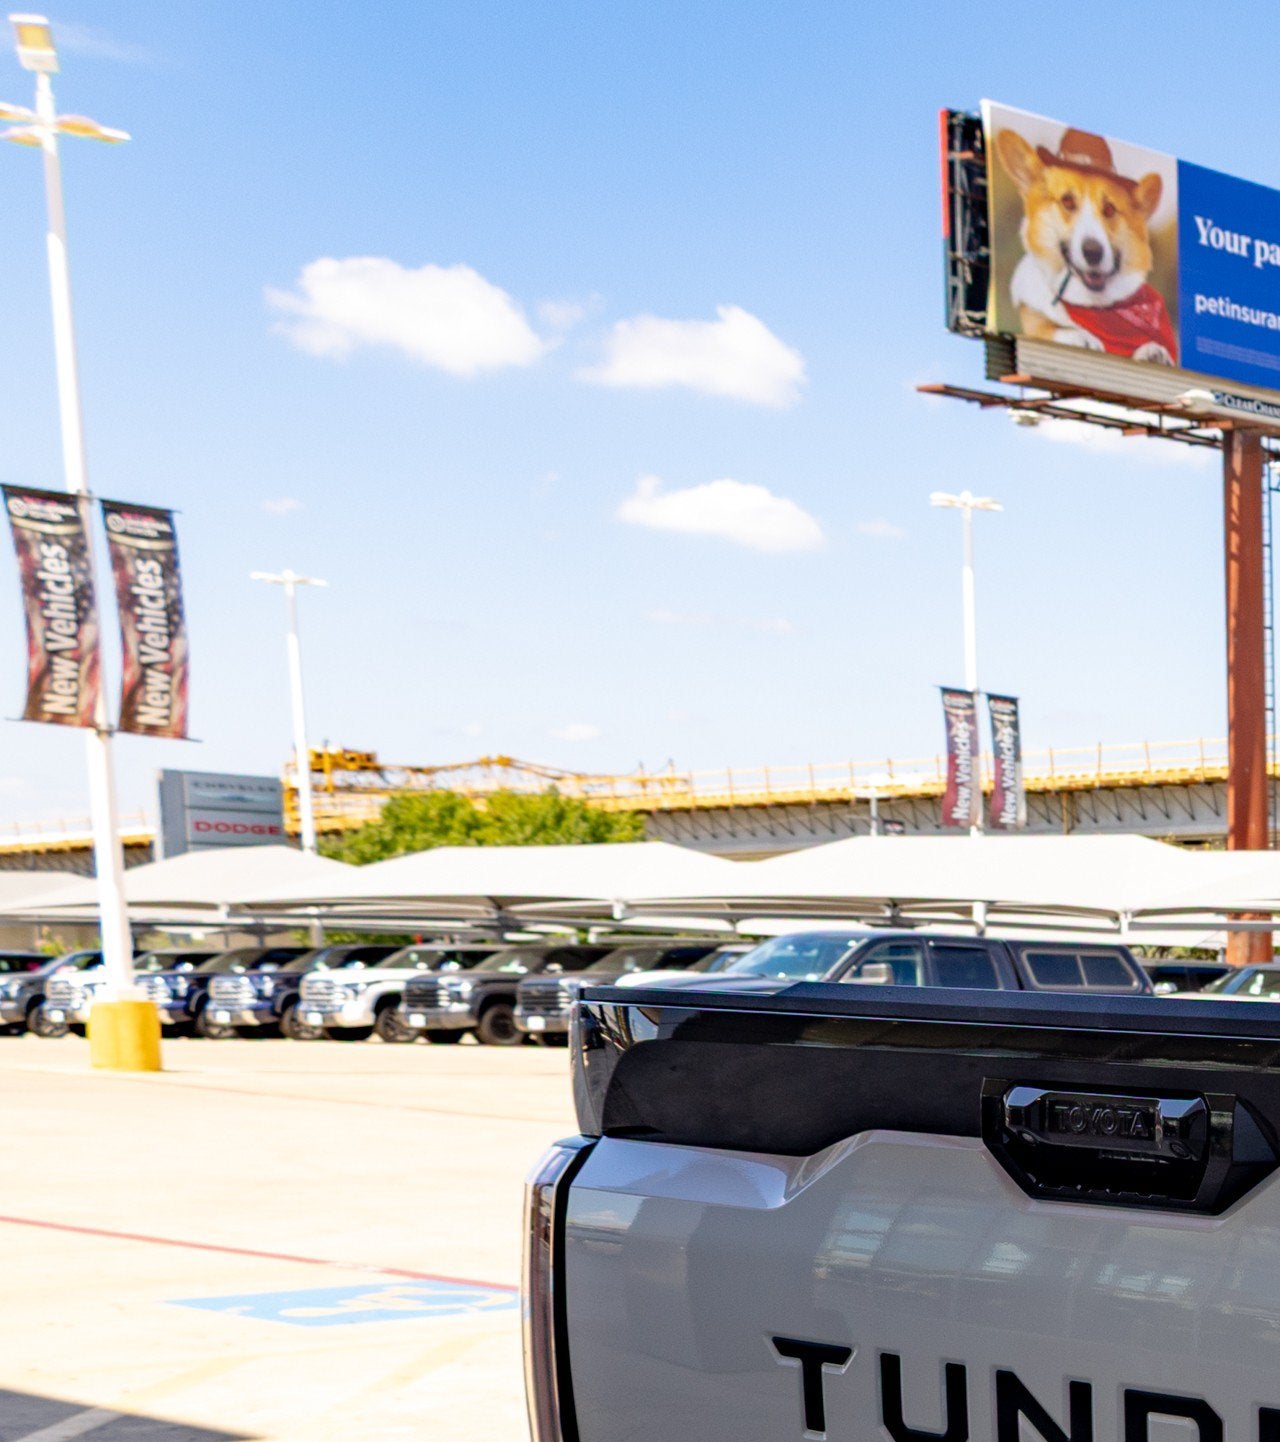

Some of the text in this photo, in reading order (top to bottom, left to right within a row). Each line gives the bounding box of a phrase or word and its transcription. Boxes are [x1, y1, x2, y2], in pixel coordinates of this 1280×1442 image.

[1193, 215, 1252, 258] Your
[36, 542, 78, 652] Vehicles
[130, 557, 170, 666] Vehicles
[41, 655, 78, 715] New
[136, 668, 171, 727] New
[194, 820, 281, 836] DODGE
[1054, 1104, 1149, 1138] TOYOTA
